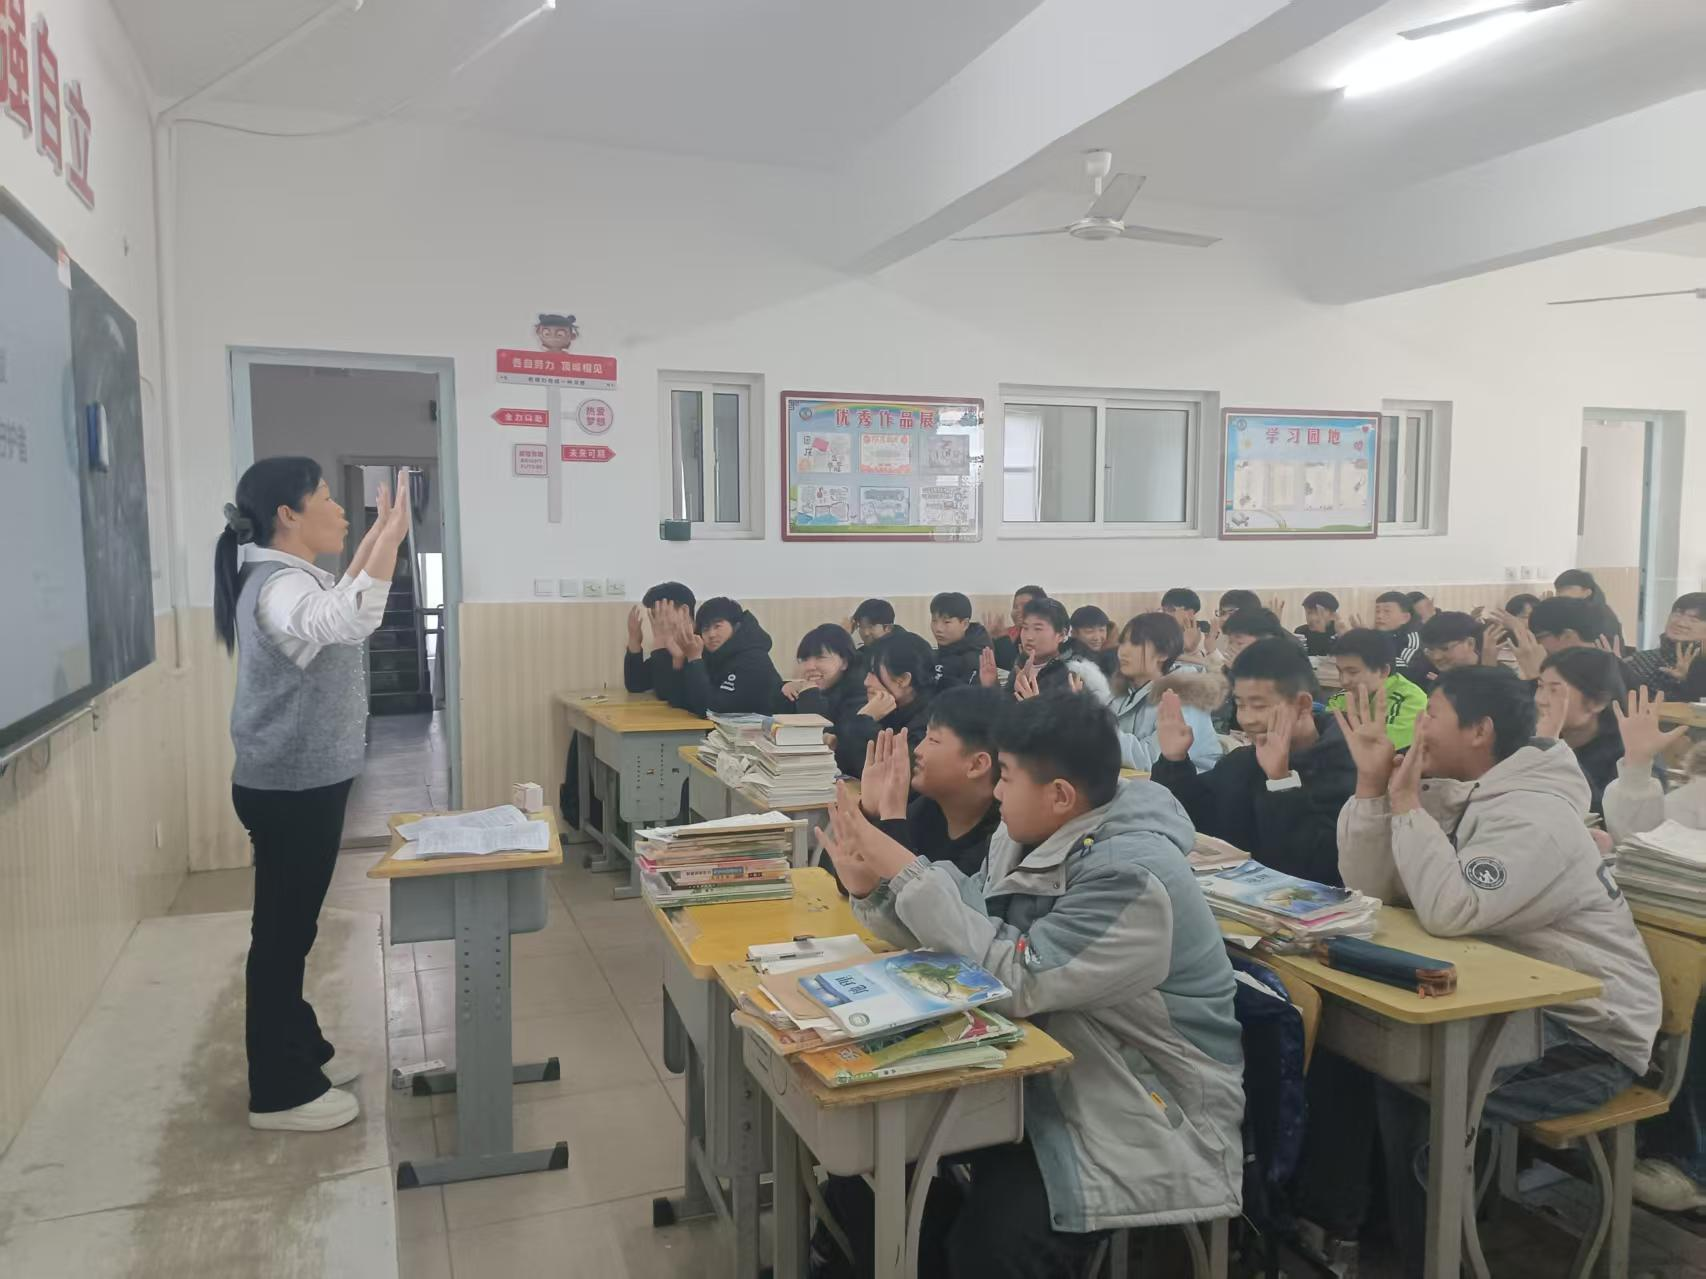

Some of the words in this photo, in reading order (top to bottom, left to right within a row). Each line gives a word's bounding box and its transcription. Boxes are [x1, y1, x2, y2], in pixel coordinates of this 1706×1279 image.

[836, 408, 936, 430] 优秀作品展
[1265, 427, 1341, 445] 学习园地
